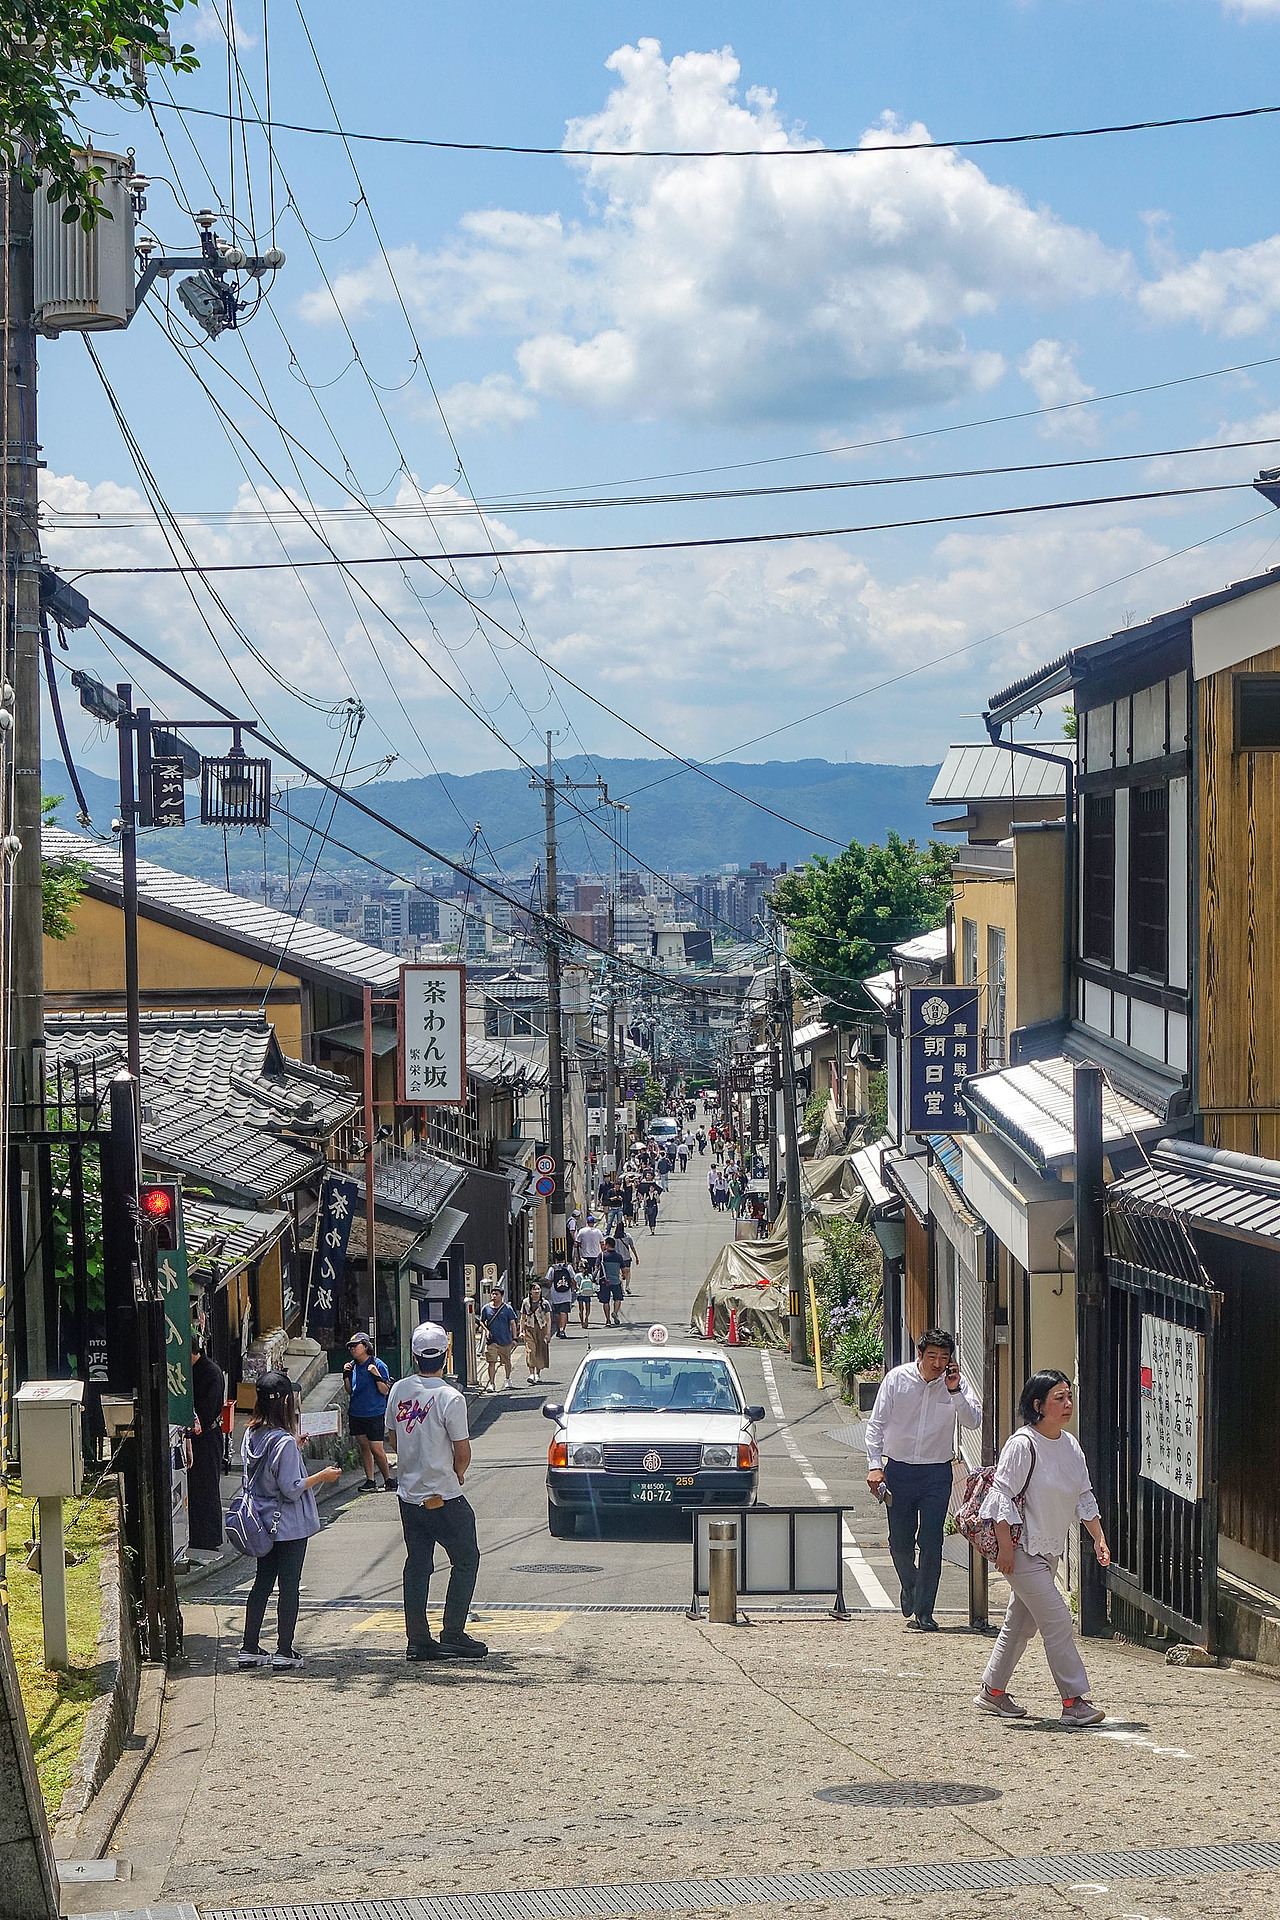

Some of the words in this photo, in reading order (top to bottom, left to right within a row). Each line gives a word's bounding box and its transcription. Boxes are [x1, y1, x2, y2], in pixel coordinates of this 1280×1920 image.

[159, 765, 185, 827] 茶わん坂
[422, 980, 448, 1089] 茶わん坂
[409, 1048, 421, 1093] 繁栄会
[923, 1036, 946, 1116] 朝日堂
[539, 1160, 551, 1171] 30
[645, 1455, 660, 1470] 都
[675, 1476, 695, 1486] 259
